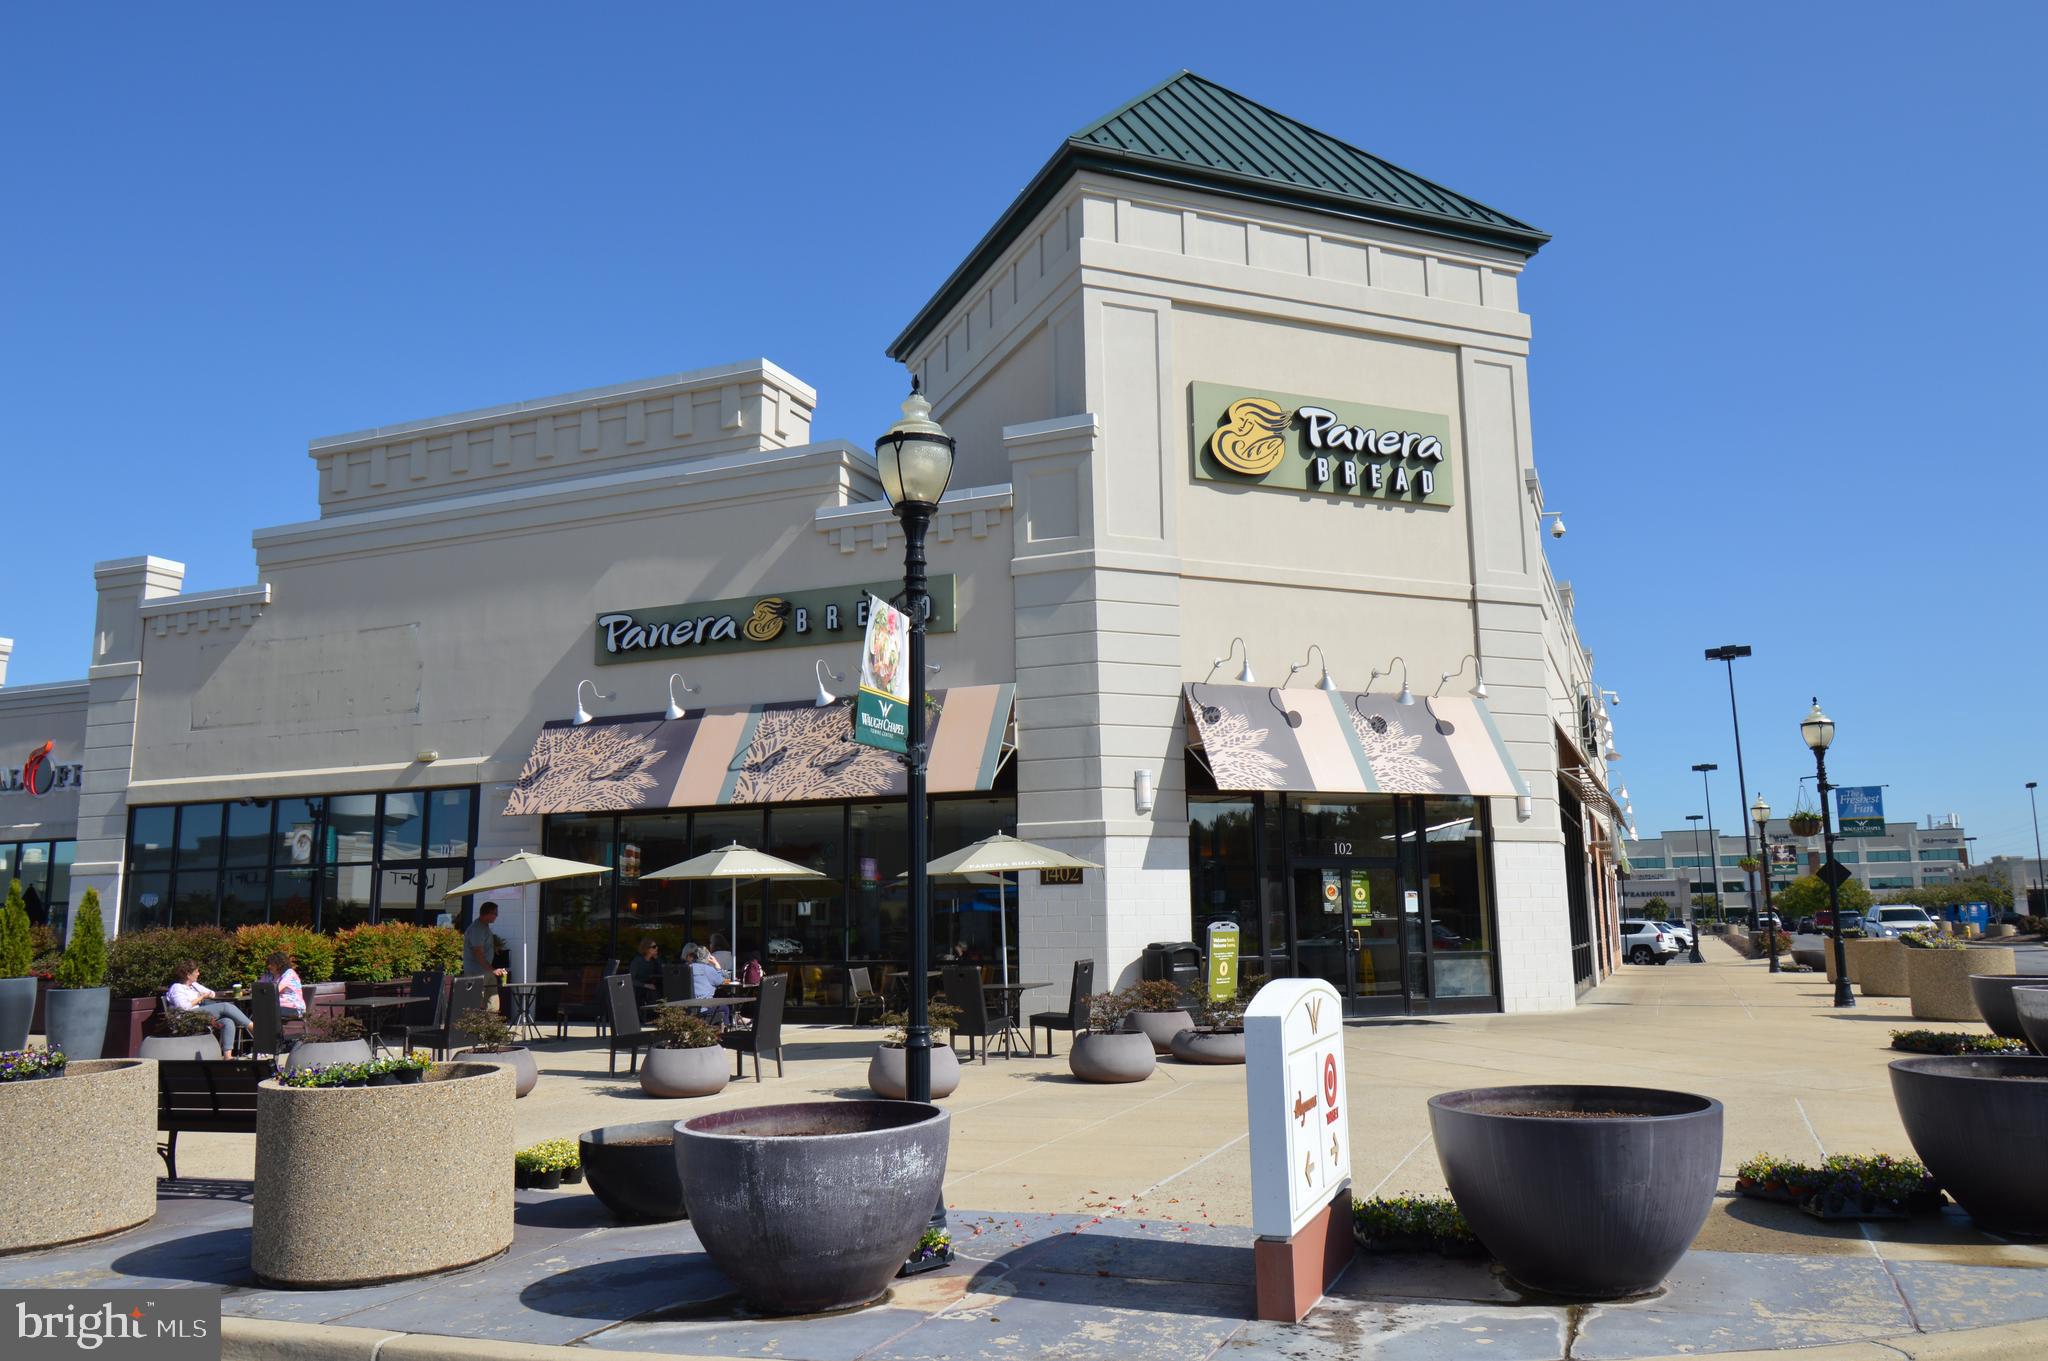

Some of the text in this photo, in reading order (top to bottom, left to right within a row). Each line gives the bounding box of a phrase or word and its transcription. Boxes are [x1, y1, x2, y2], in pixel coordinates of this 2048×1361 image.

[1299, 406, 1444, 462] Panera
[1316, 456, 1434, 494] BREAD
[599, 595, 931, 653] Panera BRED
[861, 712, 905, 735] WAUGH CHAPEL
[1840, 794, 1880, 805] Freshest
[1334, 842, 1352, 855] 102
